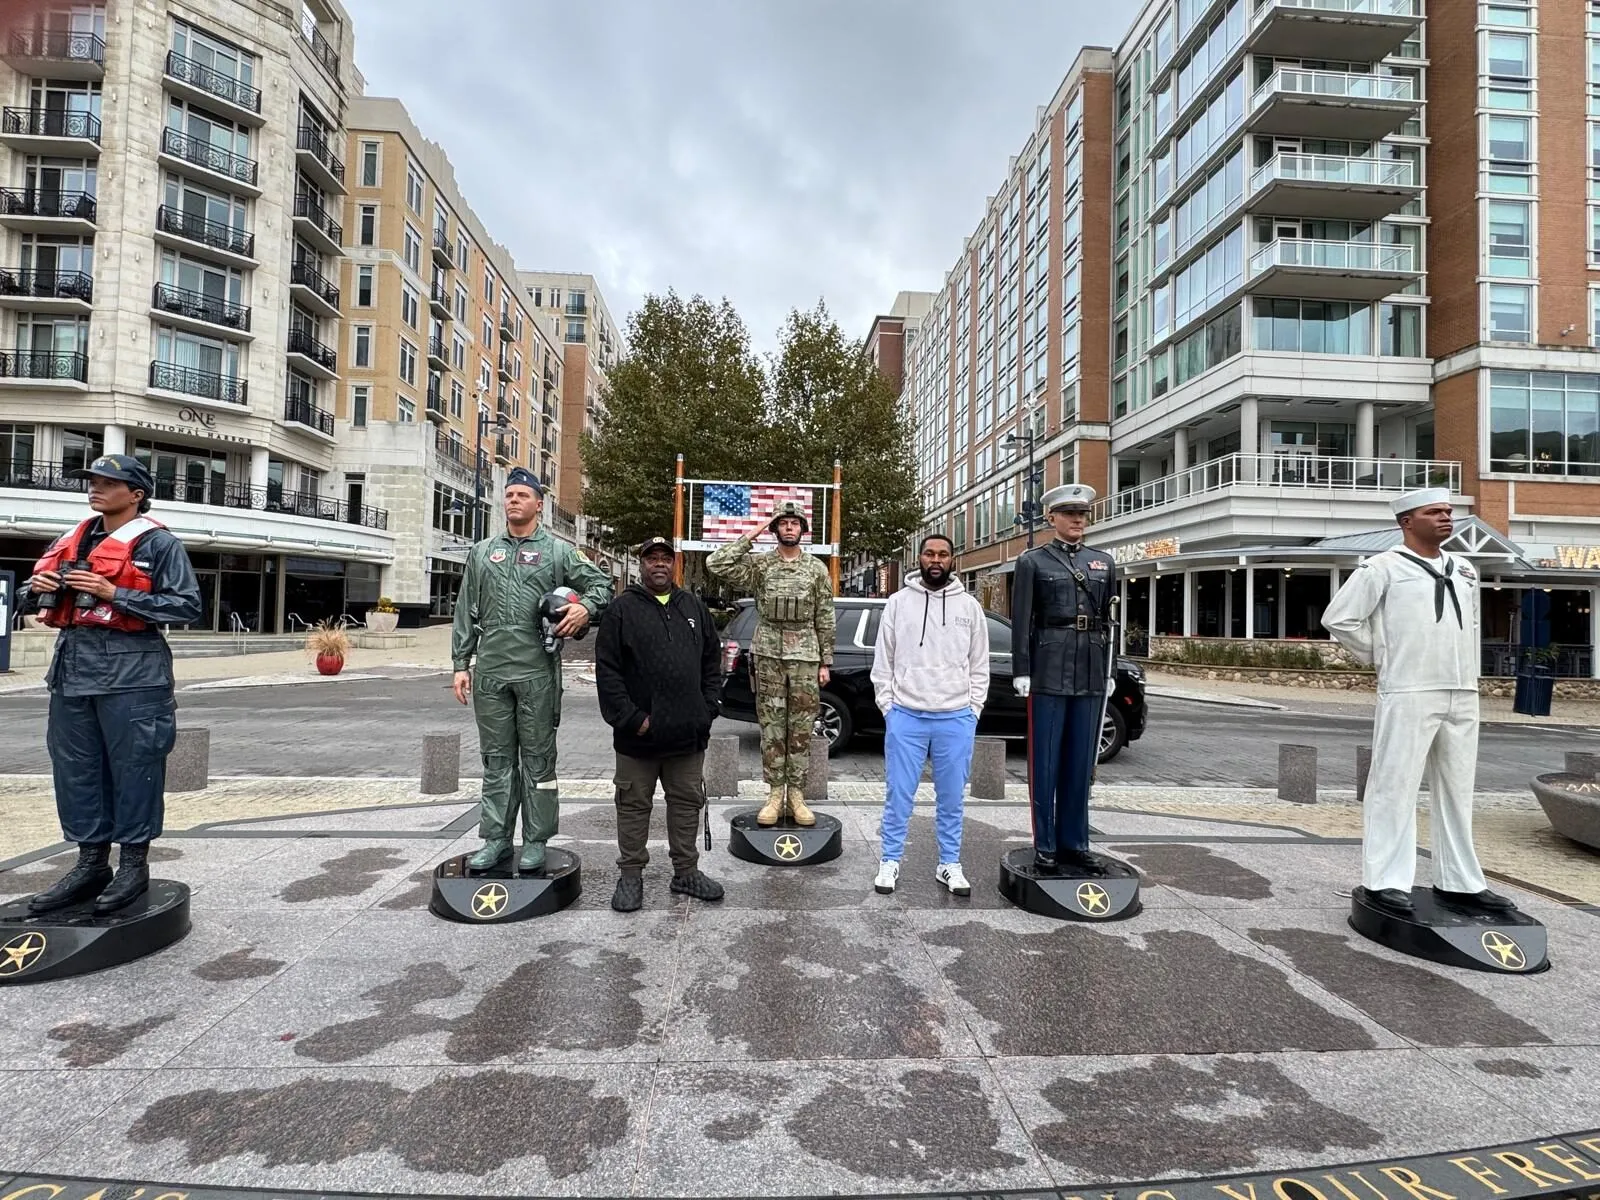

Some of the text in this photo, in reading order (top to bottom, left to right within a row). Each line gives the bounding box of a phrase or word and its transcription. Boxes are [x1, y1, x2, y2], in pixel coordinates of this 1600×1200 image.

[178, 406, 217, 429] ONE
[136, 420, 252, 444] NATIONAL HARBOR
